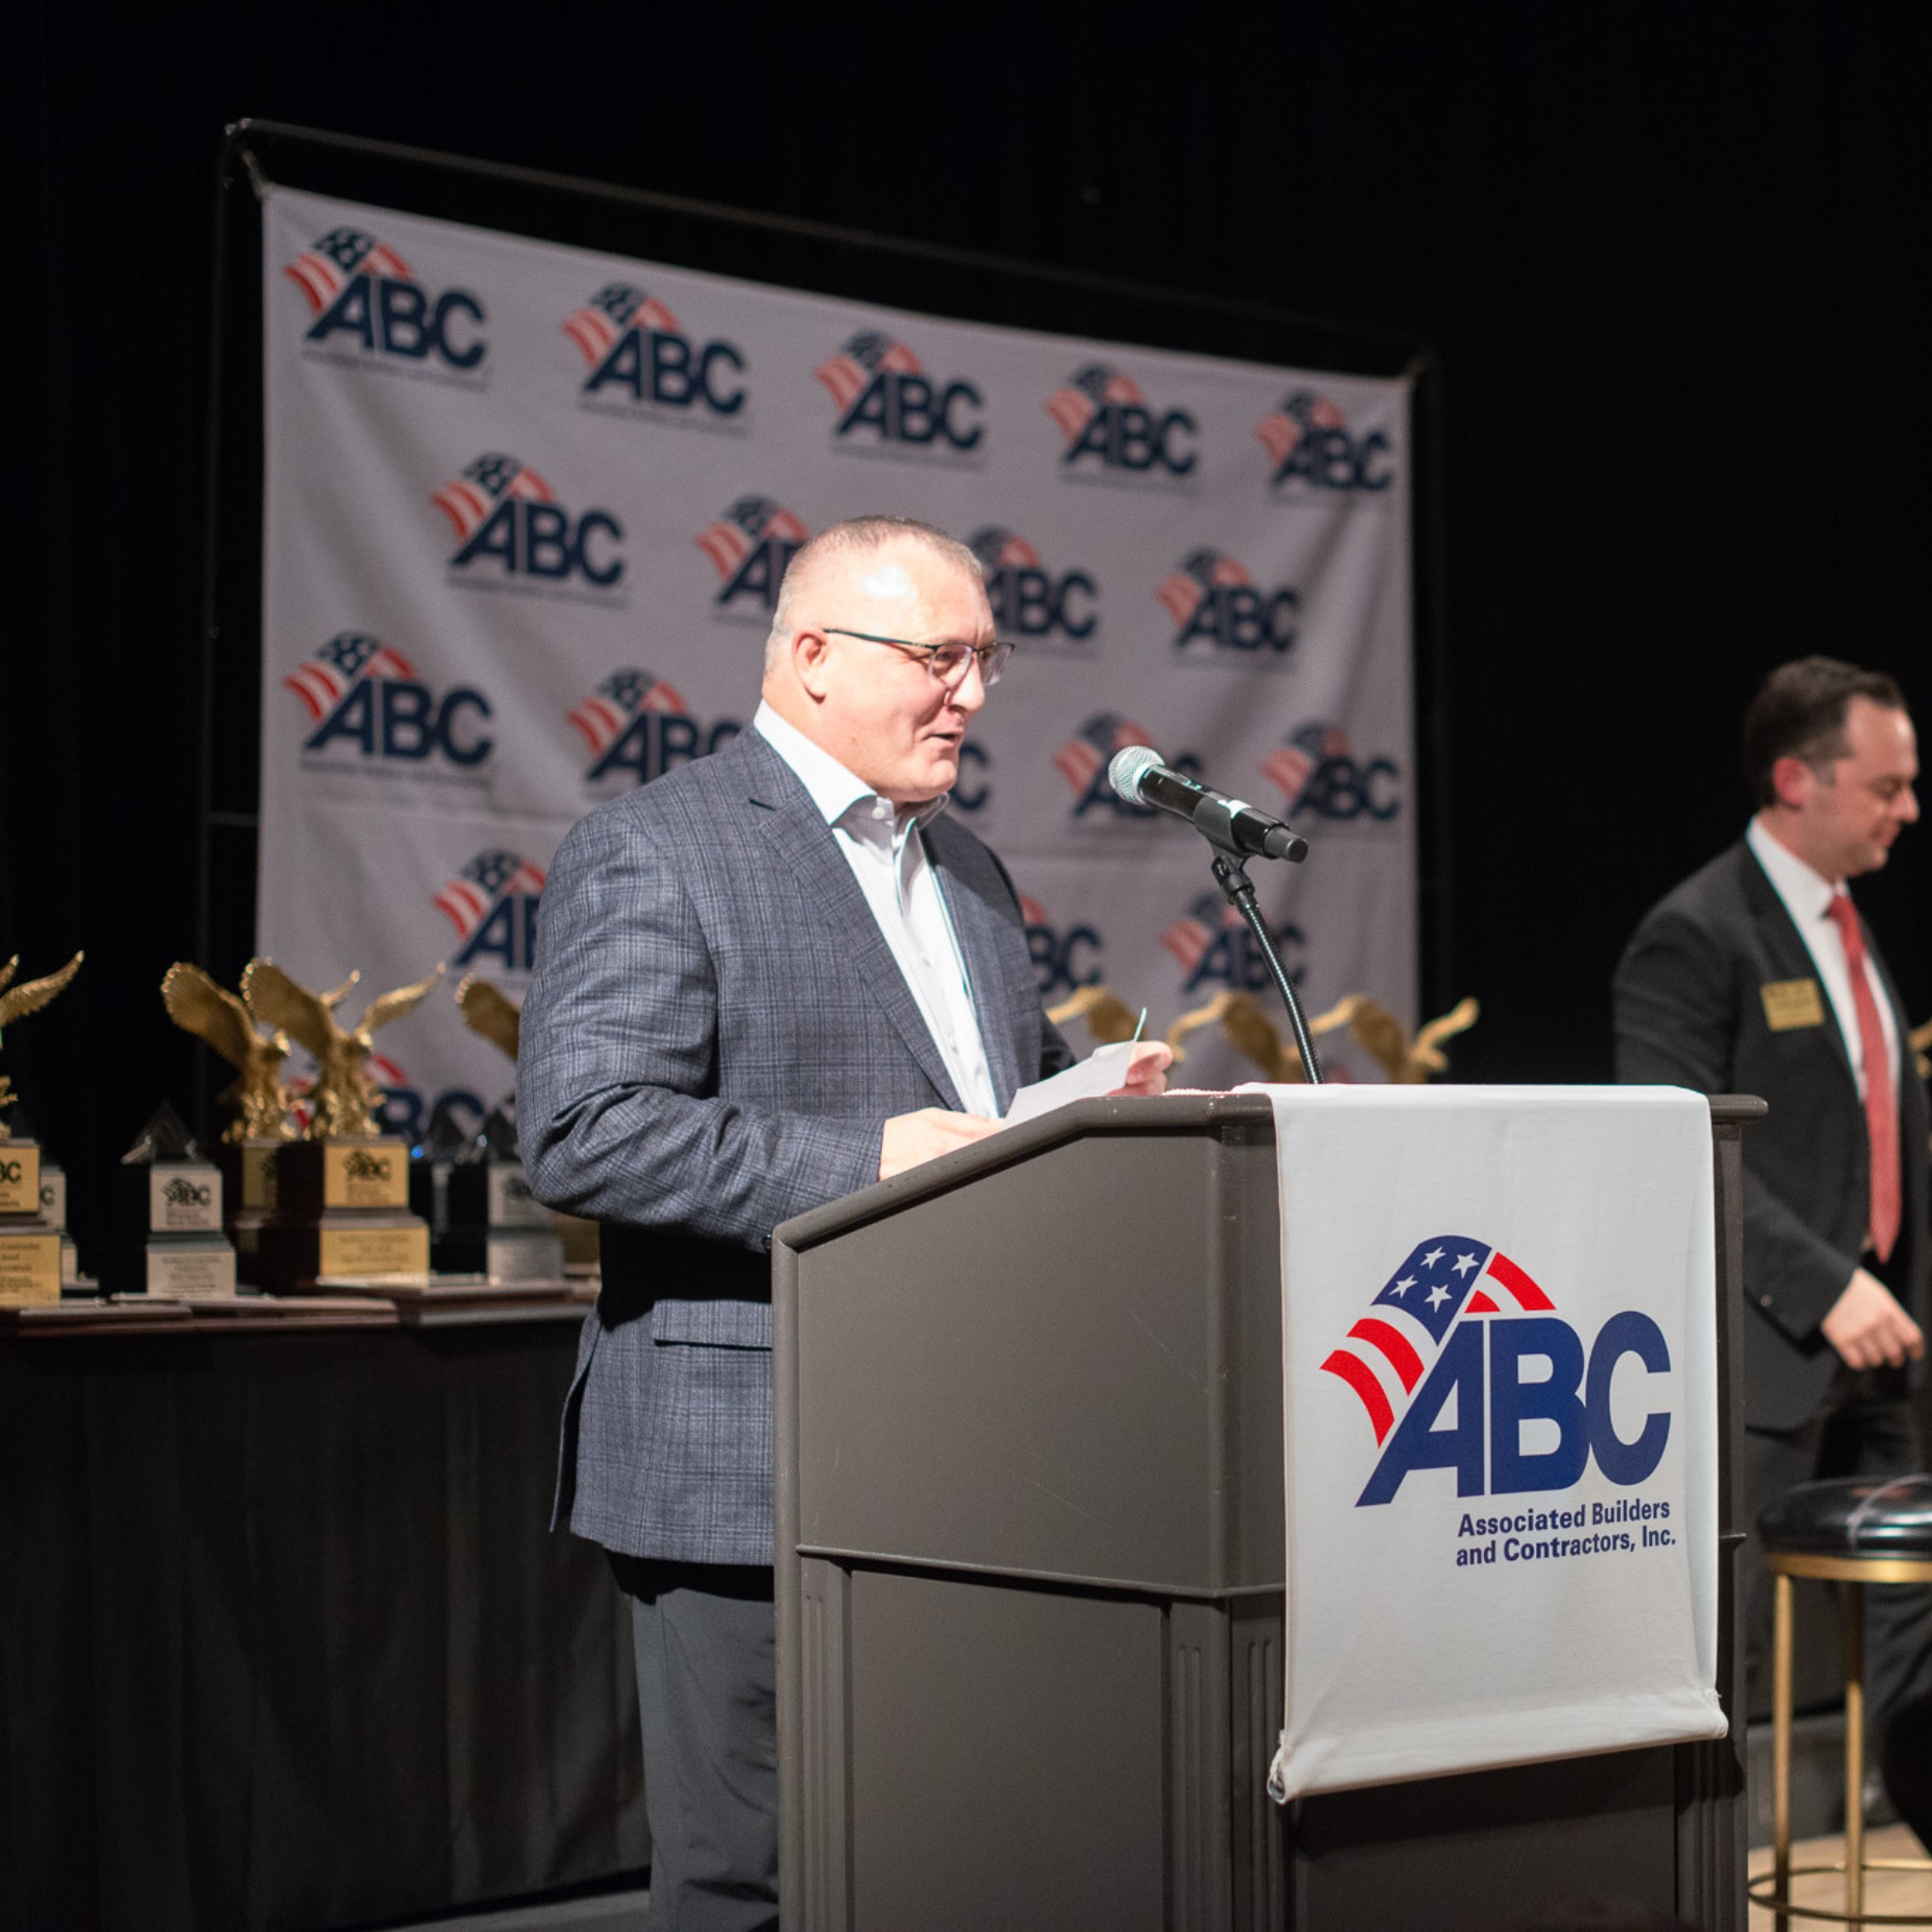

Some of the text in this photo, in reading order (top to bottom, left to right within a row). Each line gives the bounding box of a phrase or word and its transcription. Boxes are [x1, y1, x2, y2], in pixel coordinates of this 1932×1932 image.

[305, 273, 486, 369] ABC
[583, 328, 747, 416] ABC
[836, 373, 984, 450] ABC
[1065, 404, 1200, 475] ABC
[1271, 427, 1393, 491] ABC
[451, 498, 625, 587] ABC
[1176, 582, 1299, 652] ABC
[302, 676, 496, 767] ABC
[1288, 754, 1401, 820] ABC
[1022, 923, 1102, 992] BC
[1354, 1310, 1672, 1508] ABC
[1456, 1525, 1676, 1567] and Contractors, Inc.
[1458, 1498, 1670, 1537] Associated Builders
